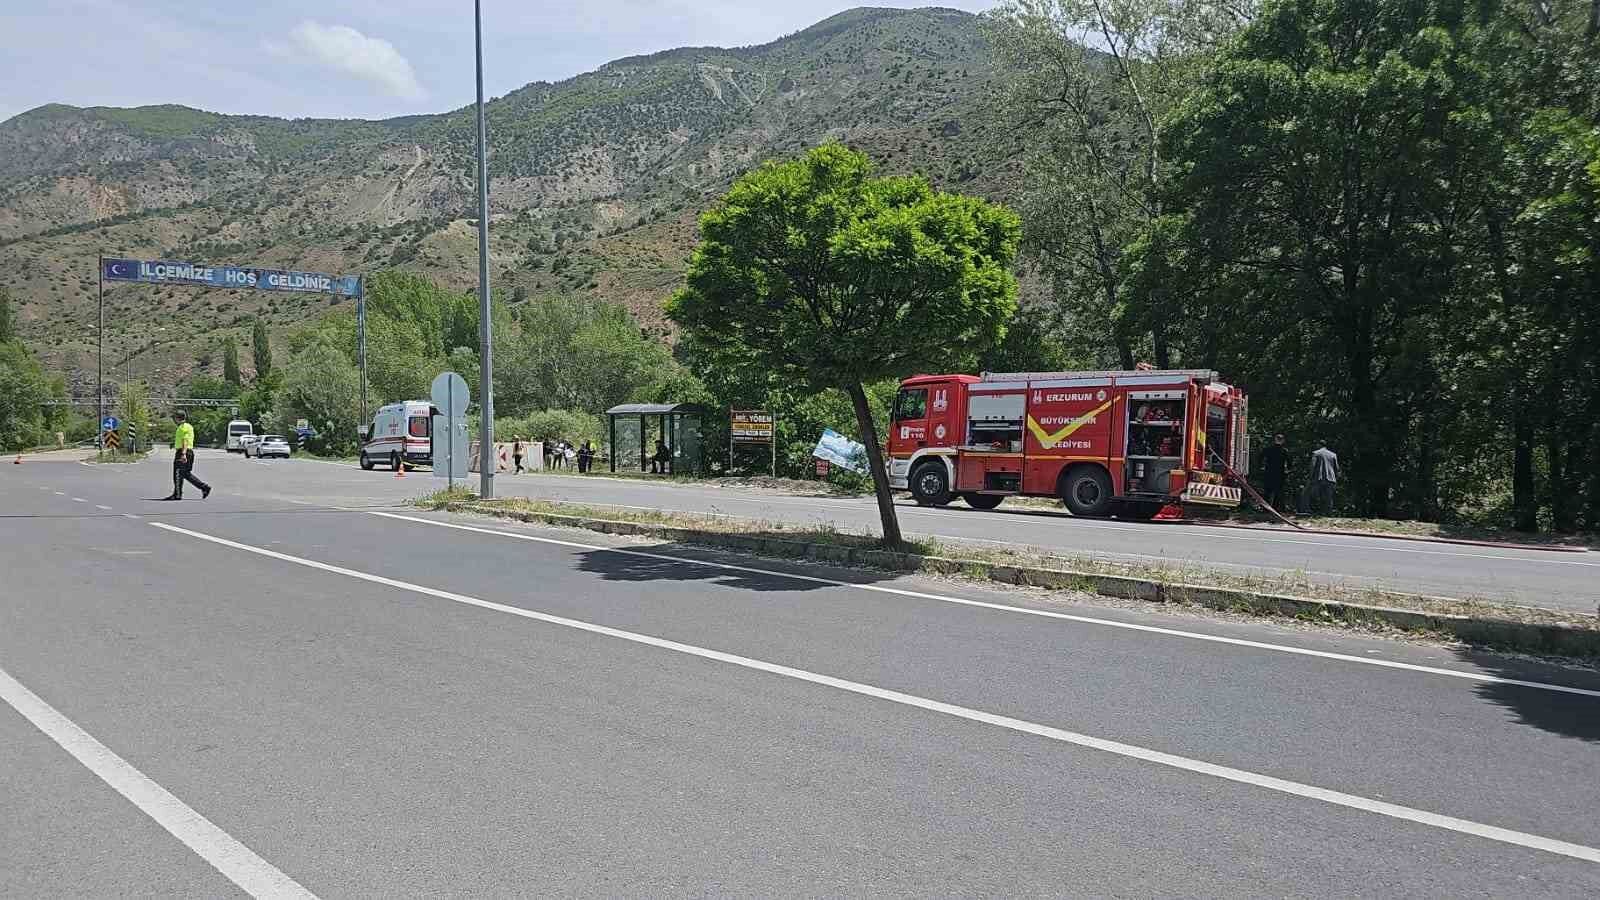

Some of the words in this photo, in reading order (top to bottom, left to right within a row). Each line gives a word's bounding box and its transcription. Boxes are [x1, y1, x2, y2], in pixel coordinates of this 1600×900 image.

[225, 270, 256, 286] HOŞ
[268, 274, 330, 290] GELDİNİZ
[1046, 393, 1093, 402] ERZURUM
[1041, 440, 1091, 449] LEDİYESİ
